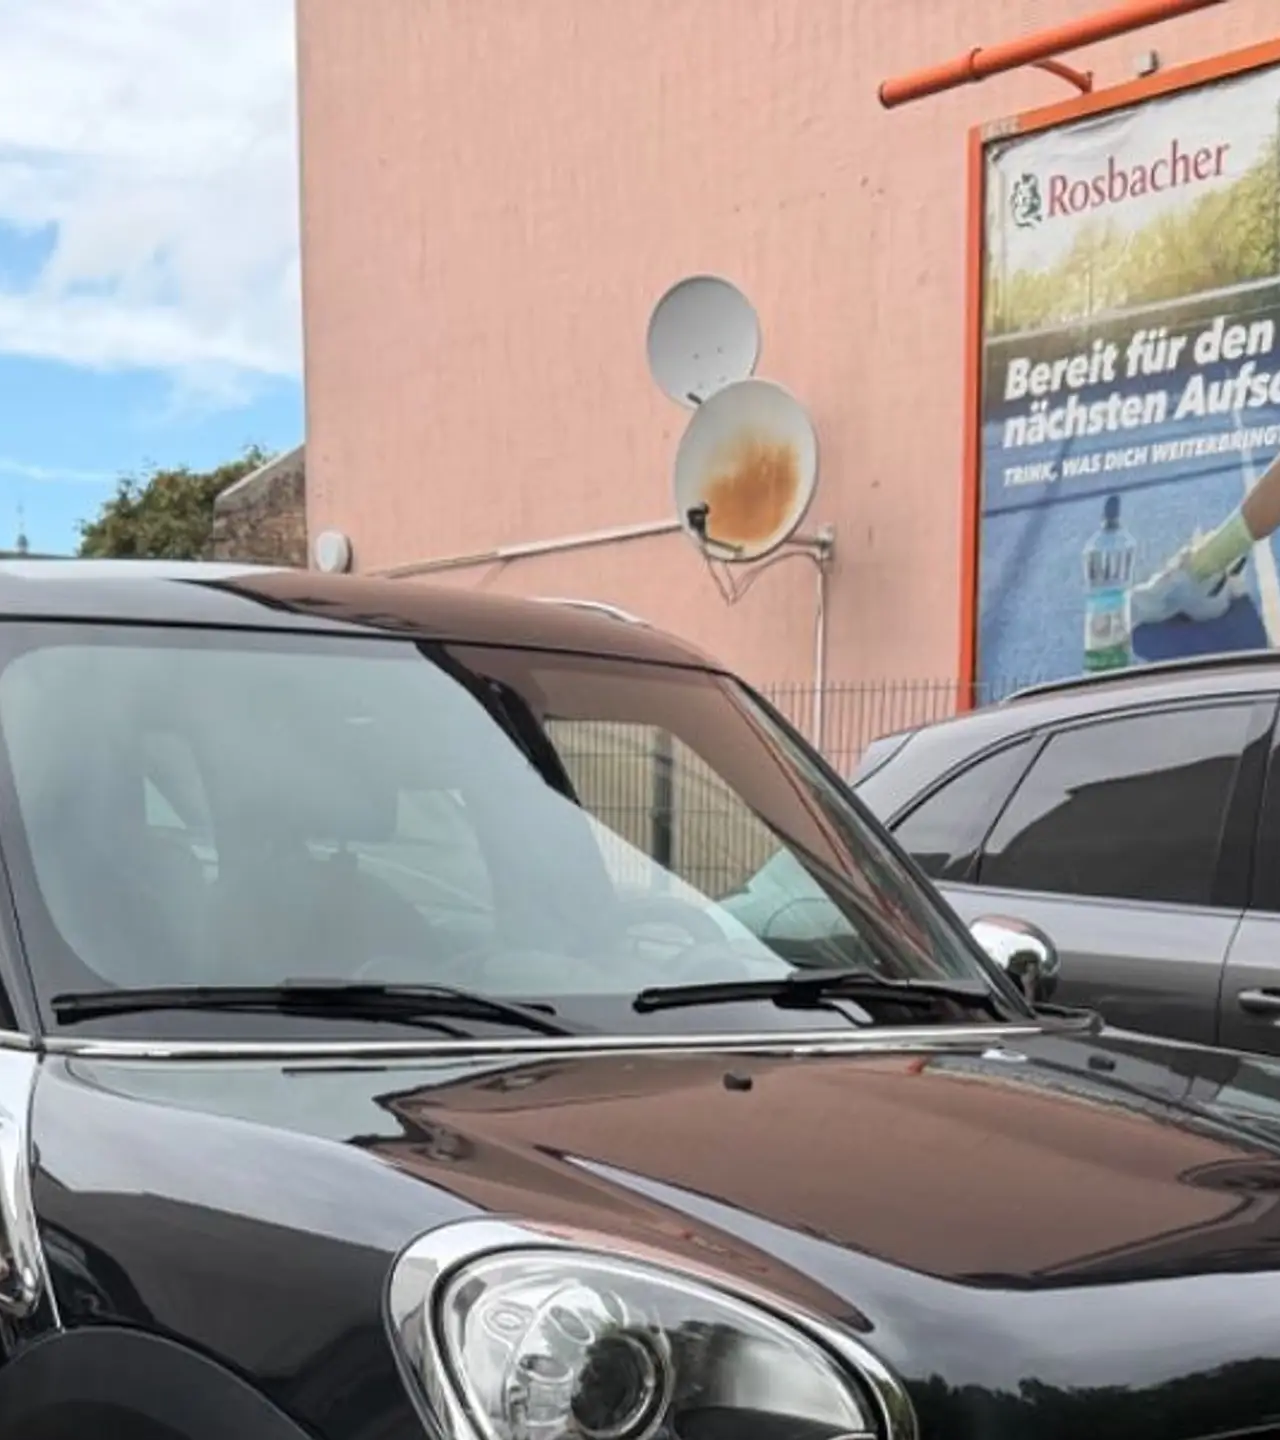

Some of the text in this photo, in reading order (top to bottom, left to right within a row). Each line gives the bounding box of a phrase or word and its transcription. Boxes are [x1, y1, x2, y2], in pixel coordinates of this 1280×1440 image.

[1046, 139, 1231, 219] Rosbacher
[1004, 316, 1275, 401] Bereit für den
[1003, 381, 1168, 449] nächsten
[1003, 462, 1058, 487] TRINK,
[1061, 453, 1102, 477] WAS
[1104, 447, 1148, 471] DICH
